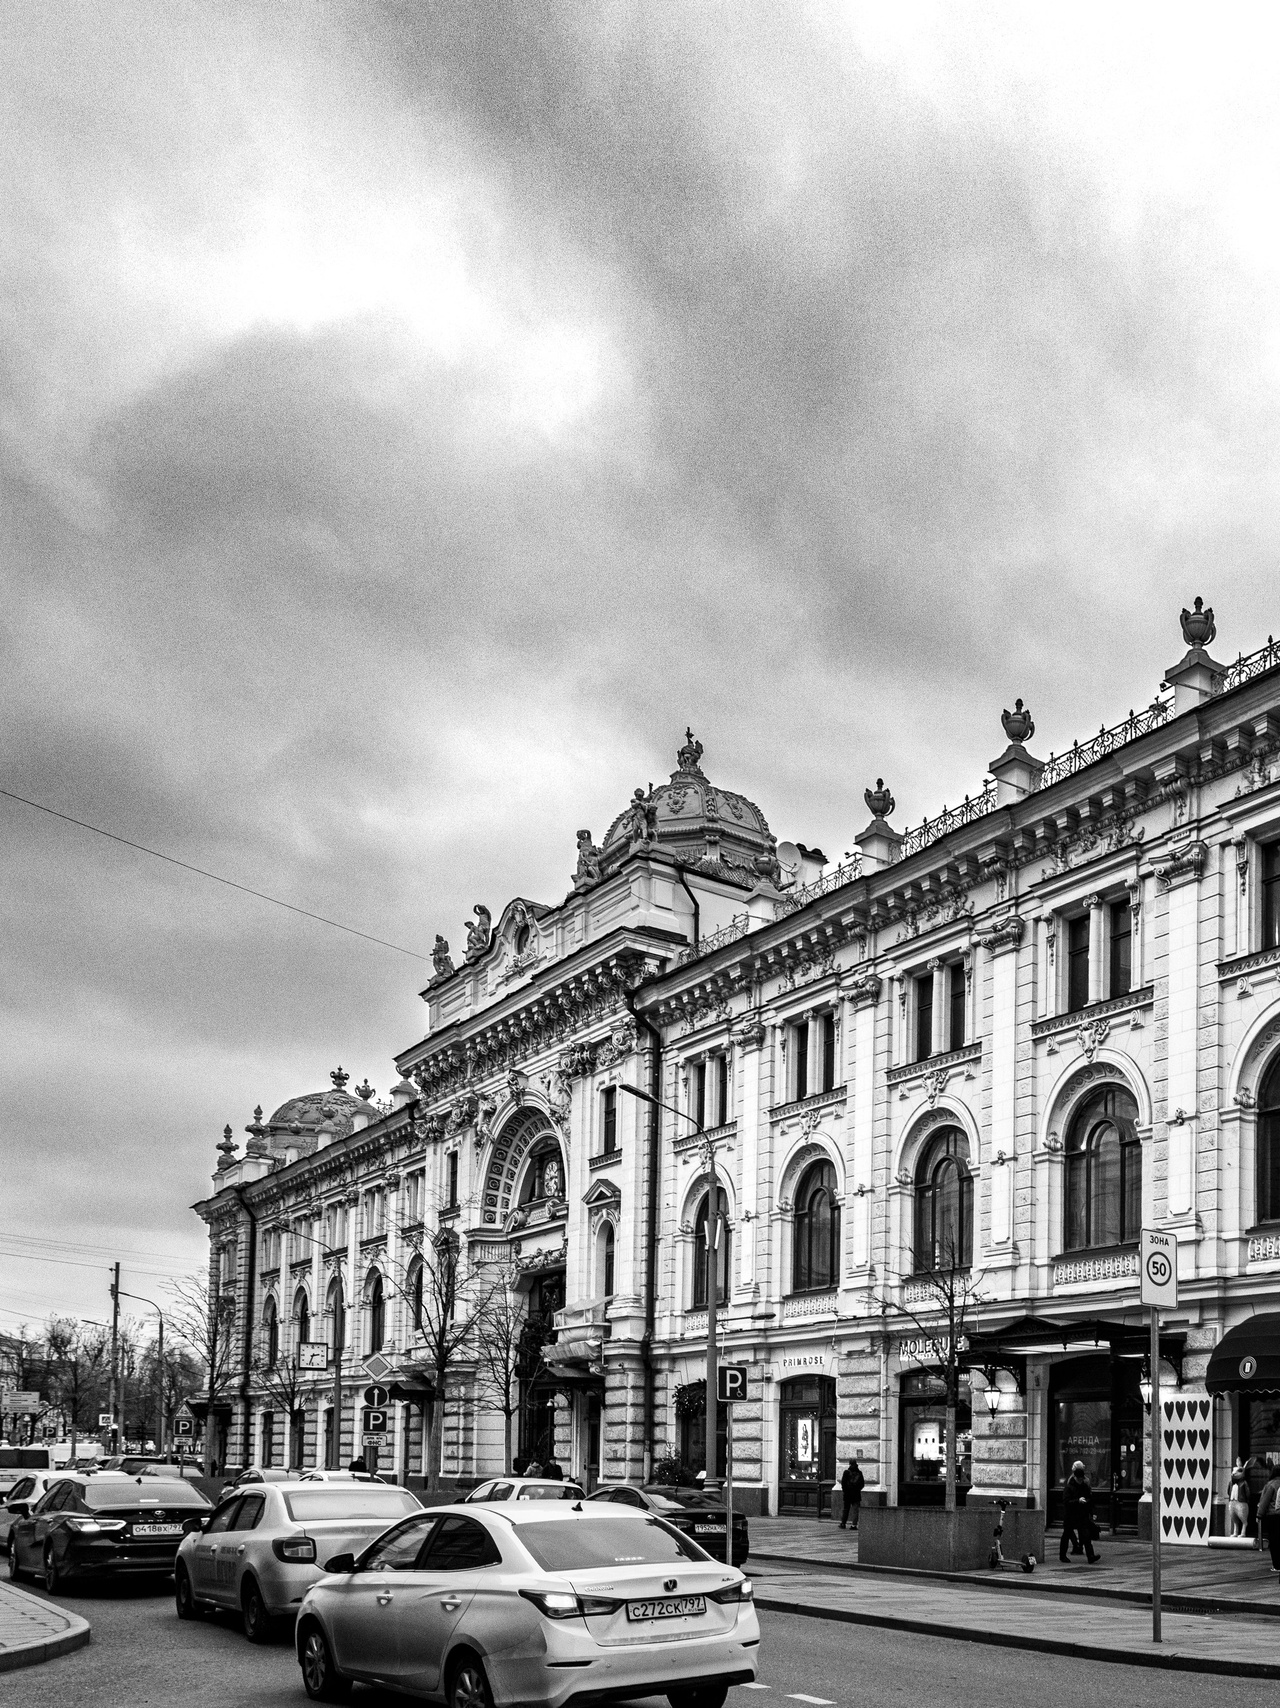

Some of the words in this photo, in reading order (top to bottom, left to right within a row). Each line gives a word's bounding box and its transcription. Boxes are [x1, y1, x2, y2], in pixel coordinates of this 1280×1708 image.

[1149, 1235, 1170, 1247] ЗОНА
[1152, 1260, 1167, 1277] 50
[899, 1335, 966, 1357] MOLECUE
[783, 1355, 824, 1367] PRIMROSE
[726, 1370, 742, 1397] P
[369, 1412, 384, 1430] P
[46, 1427, 55, 1437] P
[179, 1421, 190, 1434] P
[1067, 1435, 1100, 1446] АРЕНДА
[682, 1597, 701, 1609] 797
